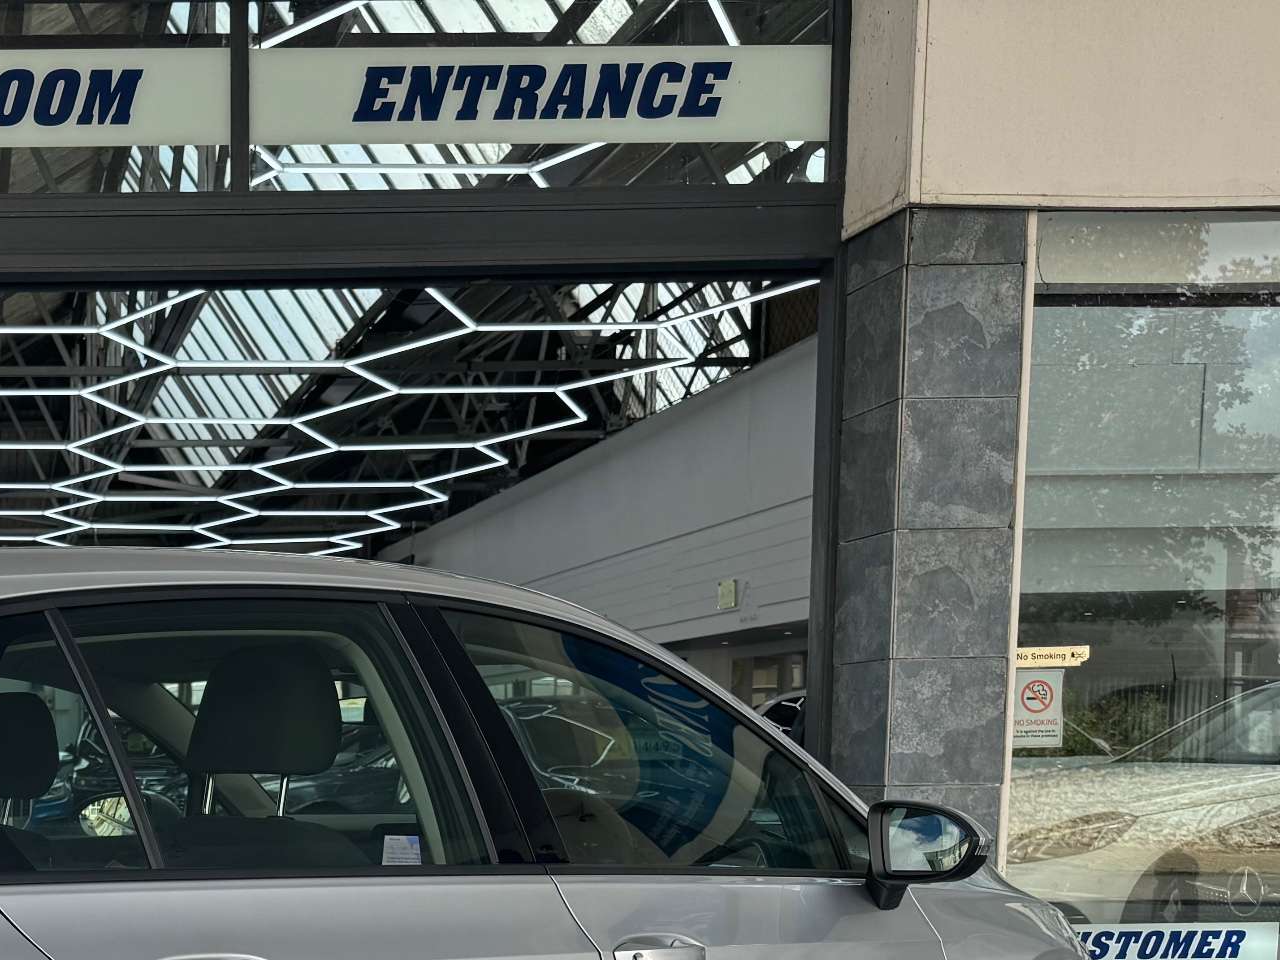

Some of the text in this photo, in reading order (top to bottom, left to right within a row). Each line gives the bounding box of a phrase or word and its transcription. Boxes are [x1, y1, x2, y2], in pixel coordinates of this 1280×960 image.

[351, 61, 732, 122] ENTRANCE
[1016, 652, 1067, 662] No Smoking
[1014, 718, 1058, 727] NO SMOKING
[1077, 930, 1247, 960] STOMER
